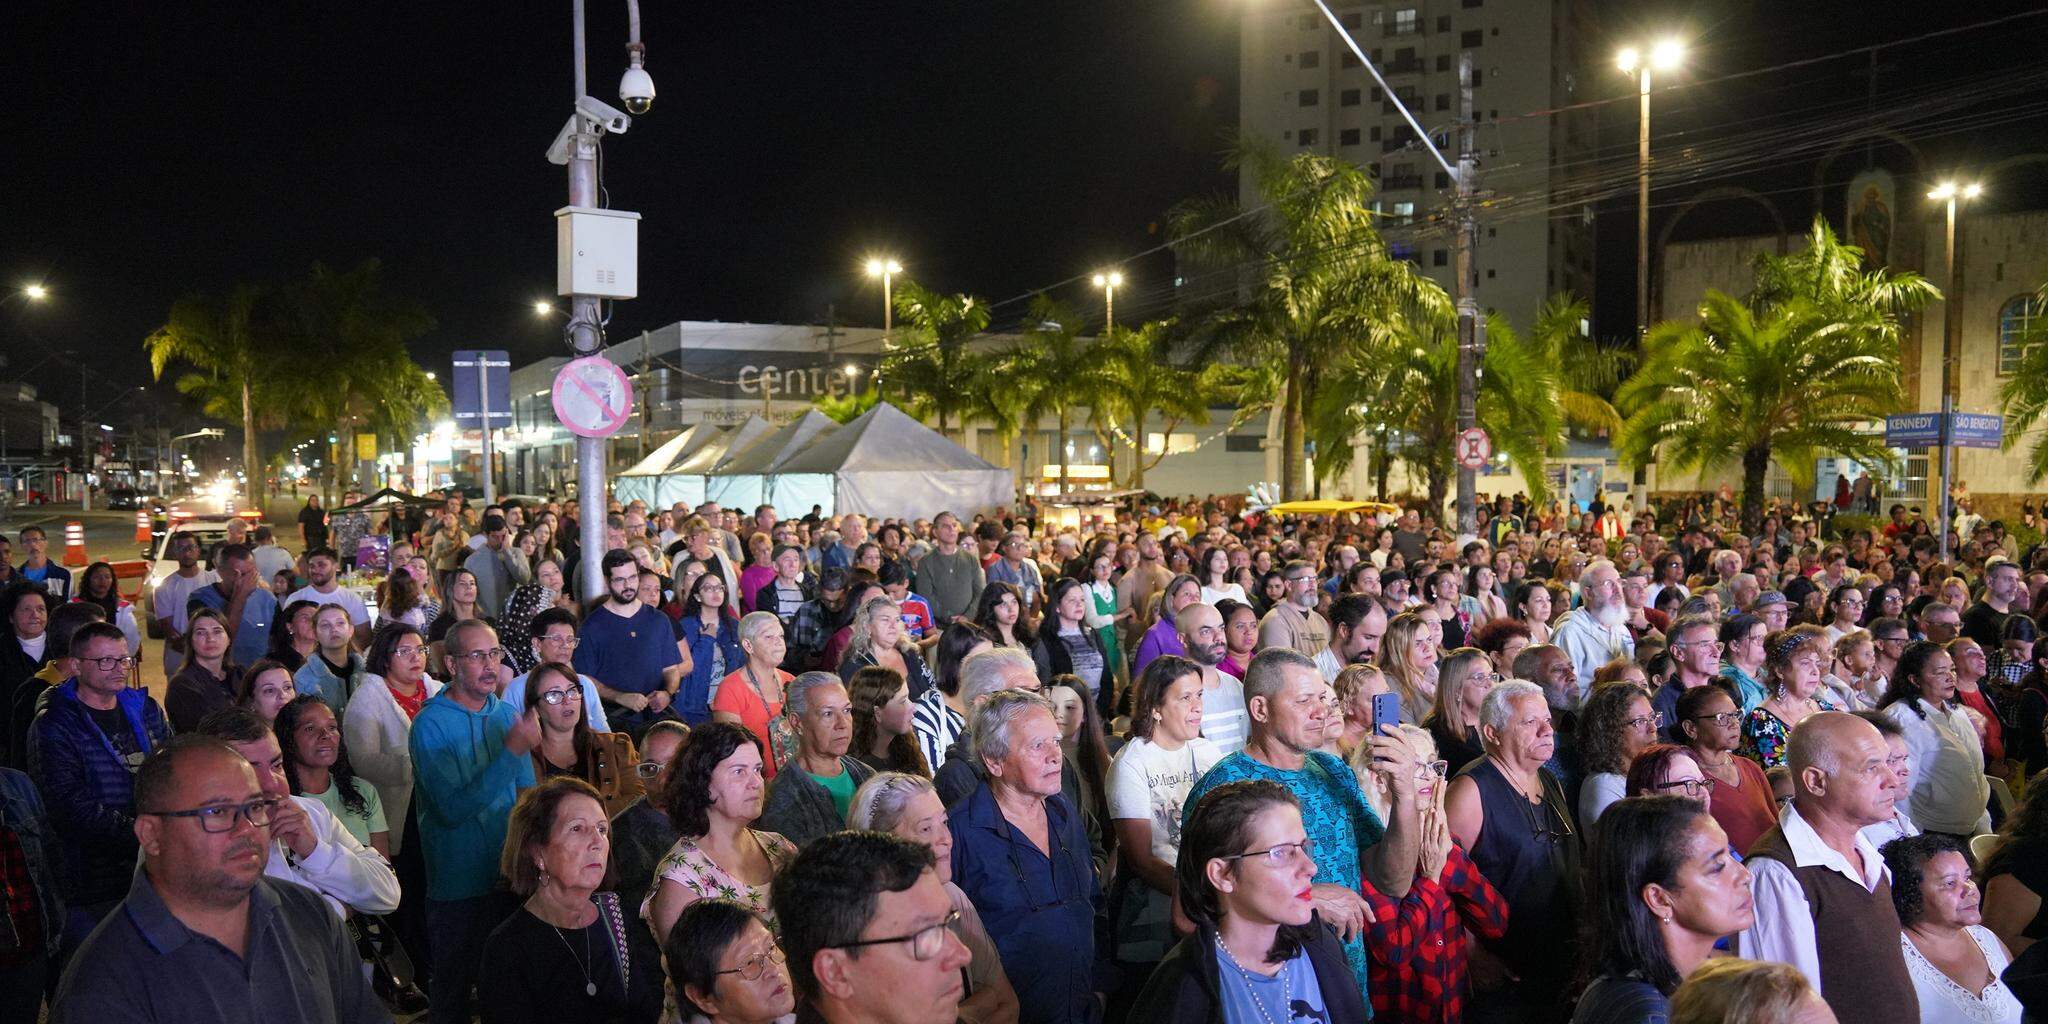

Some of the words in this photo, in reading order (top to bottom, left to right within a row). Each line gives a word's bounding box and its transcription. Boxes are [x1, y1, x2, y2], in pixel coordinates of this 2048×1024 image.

[1889, 416, 1933, 430] KENNEDY
[1955, 414, 1969, 429] SÃO
[1970, 417, 2000, 431] BENEDITO
